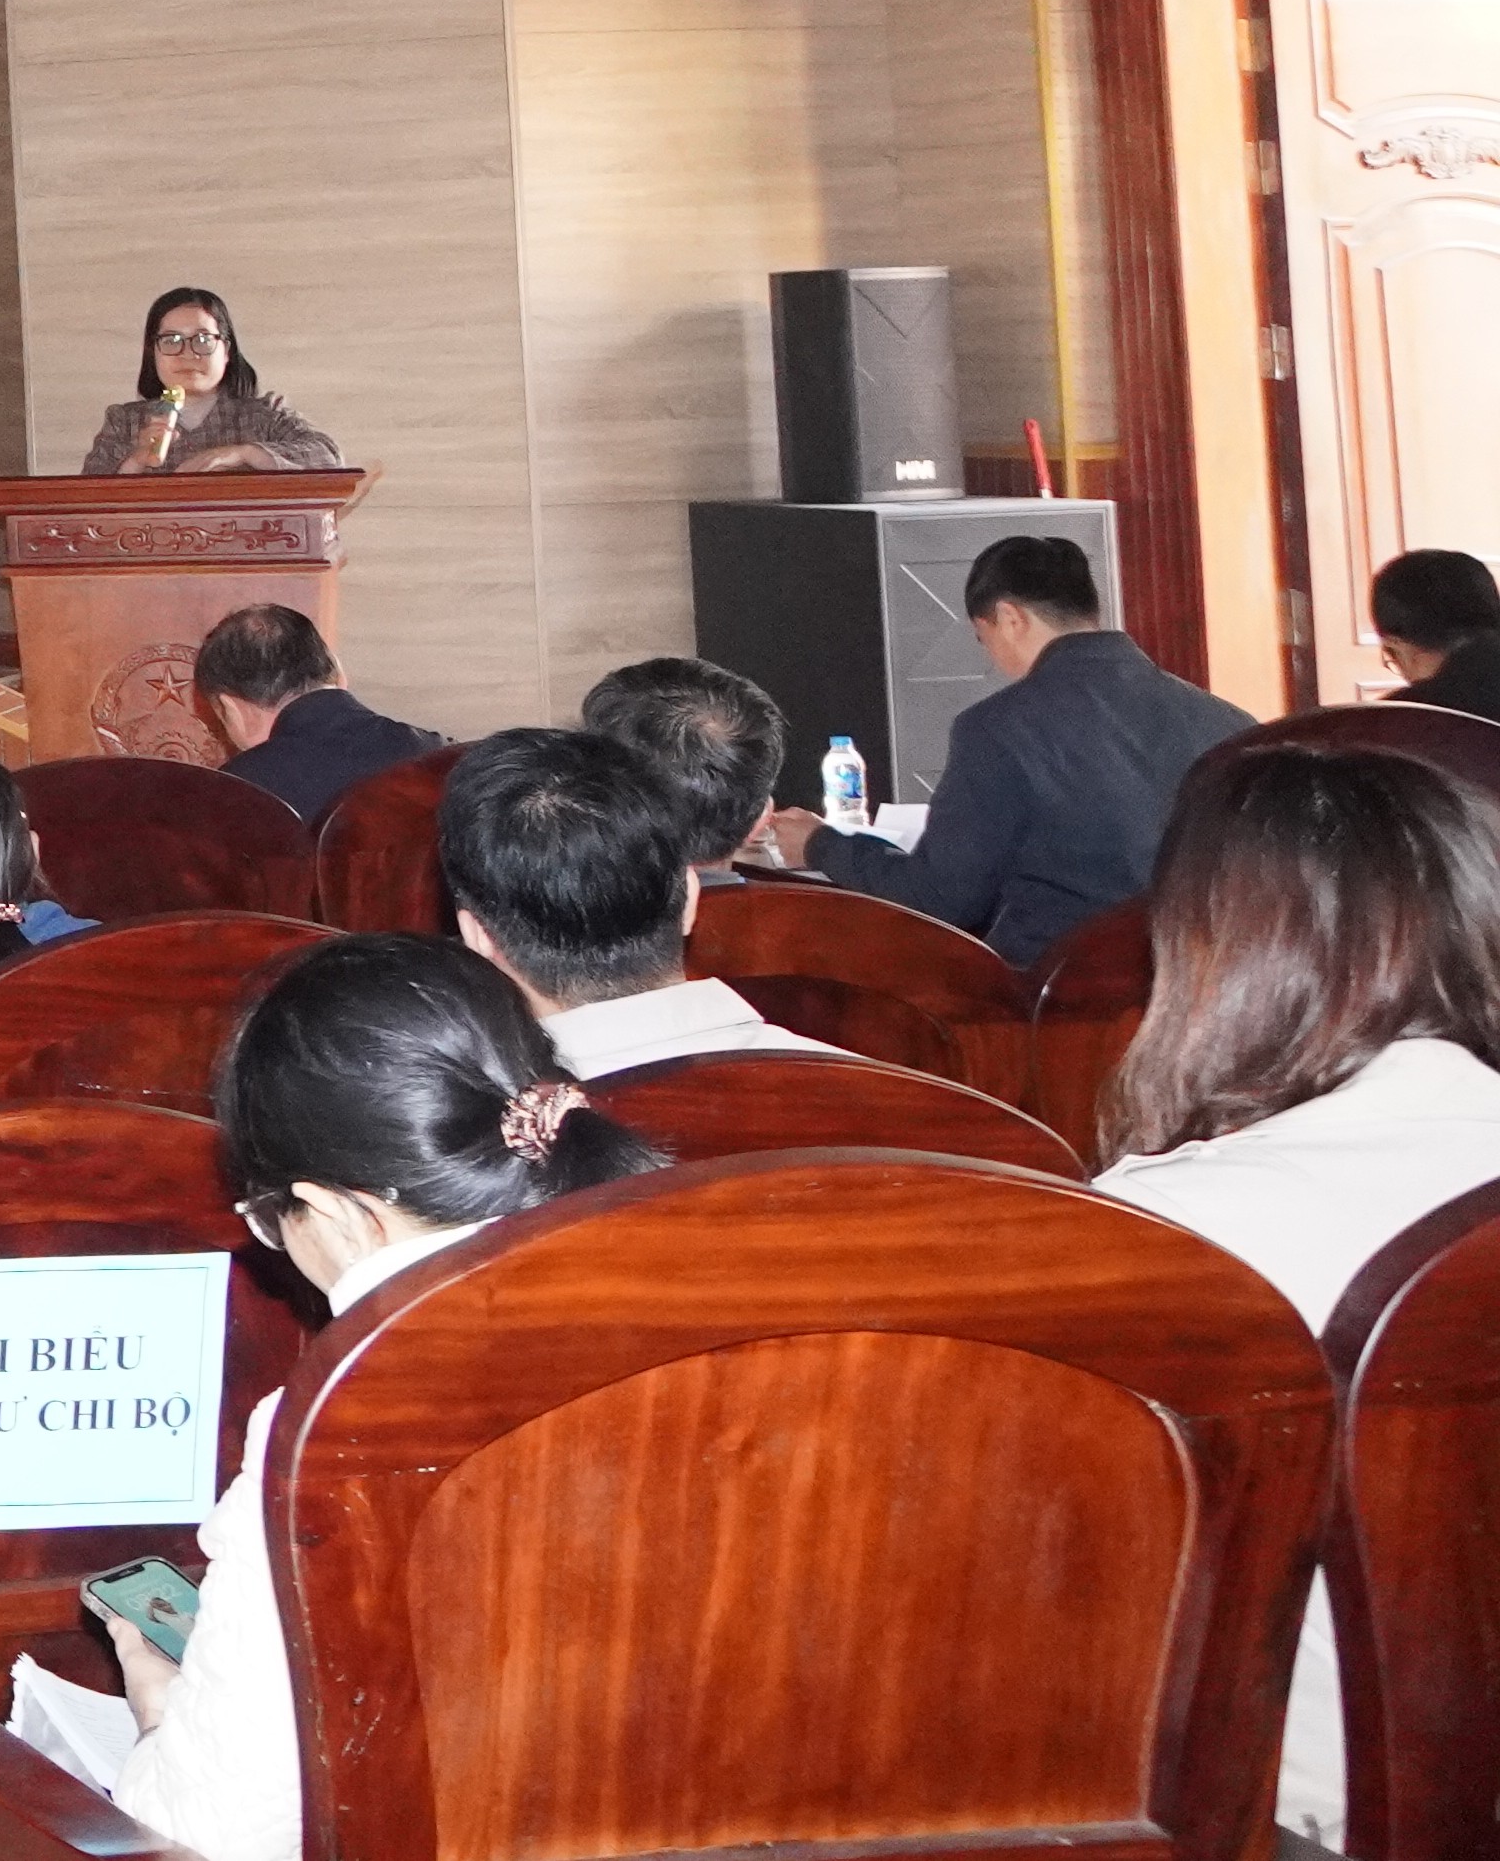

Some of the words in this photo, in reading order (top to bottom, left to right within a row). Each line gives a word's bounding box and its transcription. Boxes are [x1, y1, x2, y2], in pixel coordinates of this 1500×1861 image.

[29, 1325, 146, 1373] BIỂU
[38, 1398, 117, 1433] CHI
[133, 1391, 192, 1437] BỘ
